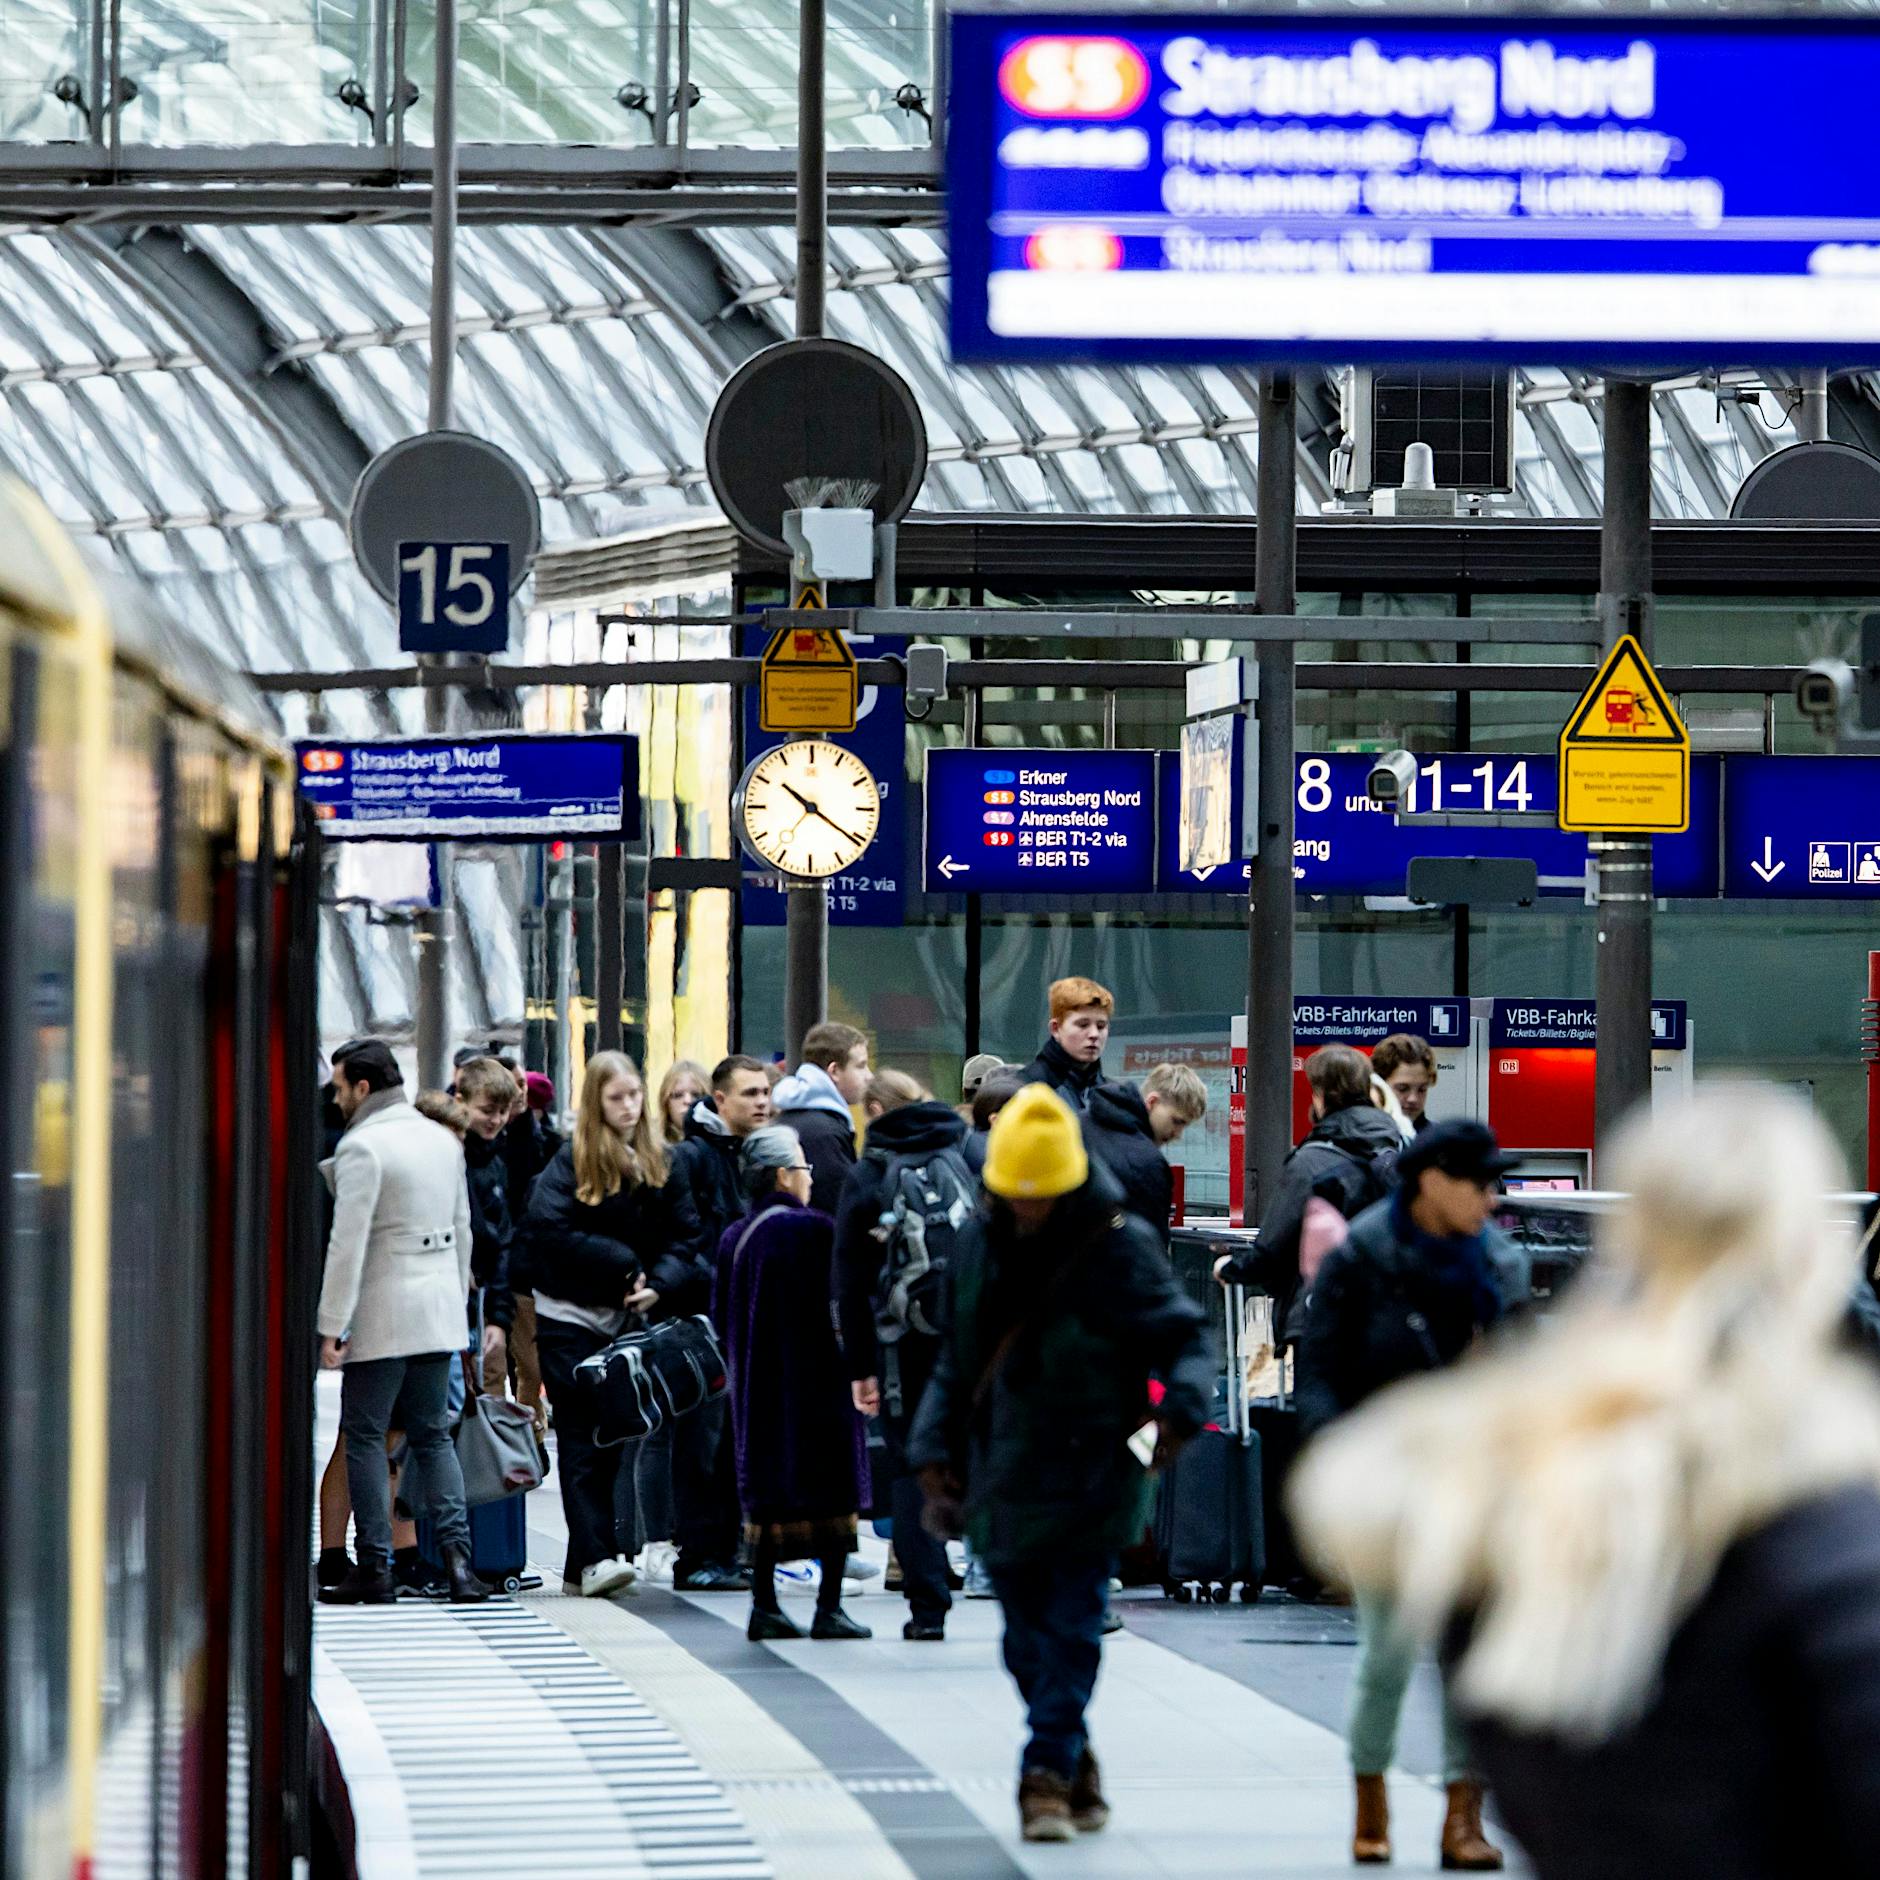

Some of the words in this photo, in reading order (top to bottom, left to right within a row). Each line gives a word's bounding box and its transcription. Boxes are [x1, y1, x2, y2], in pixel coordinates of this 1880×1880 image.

[1160, 36, 1497, 133] Strausberg
[1501, 39, 1656, 118] Nord
[402, 545, 495, 627] 15
[351, 748, 452, 773] Strausberg
[452, 745, 500, 769] Nord
[1019, 769, 1068, 785] Erkner
[1297, 758, 1332, 812] 8
[990, 792, 1009, 804] S5
[1019, 789, 1101, 809] Strausberg
[1104, 789, 1141, 806] Nord
[990, 811, 1009, 824] S7
[1019, 810, 1109, 826] Ahrensfelde
[989, 832, 1009, 846] S9
[1035, 831, 1067, 846] BER
[1070, 831, 1101, 847] T1-2
[1105, 832, 1128, 846] via
[1035, 851, 1067, 867] BER
[1070, 851, 1090, 867] T5
[1812, 868, 1843, 878] Polizei
[839, 876, 870, 891] T1-2
[873, 876, 896, 892] via
[839, 896, 857, 911] T5
[1293, 1006, 1417, 1023] VBB-Fahrkarten
[1506, 1008, 1598, 1026] VBB-Fahrka
[1506, 1028, 1597, 1040] Tickets/Billets/Biglie
[1502, 1060, 1517, 1071] DB
